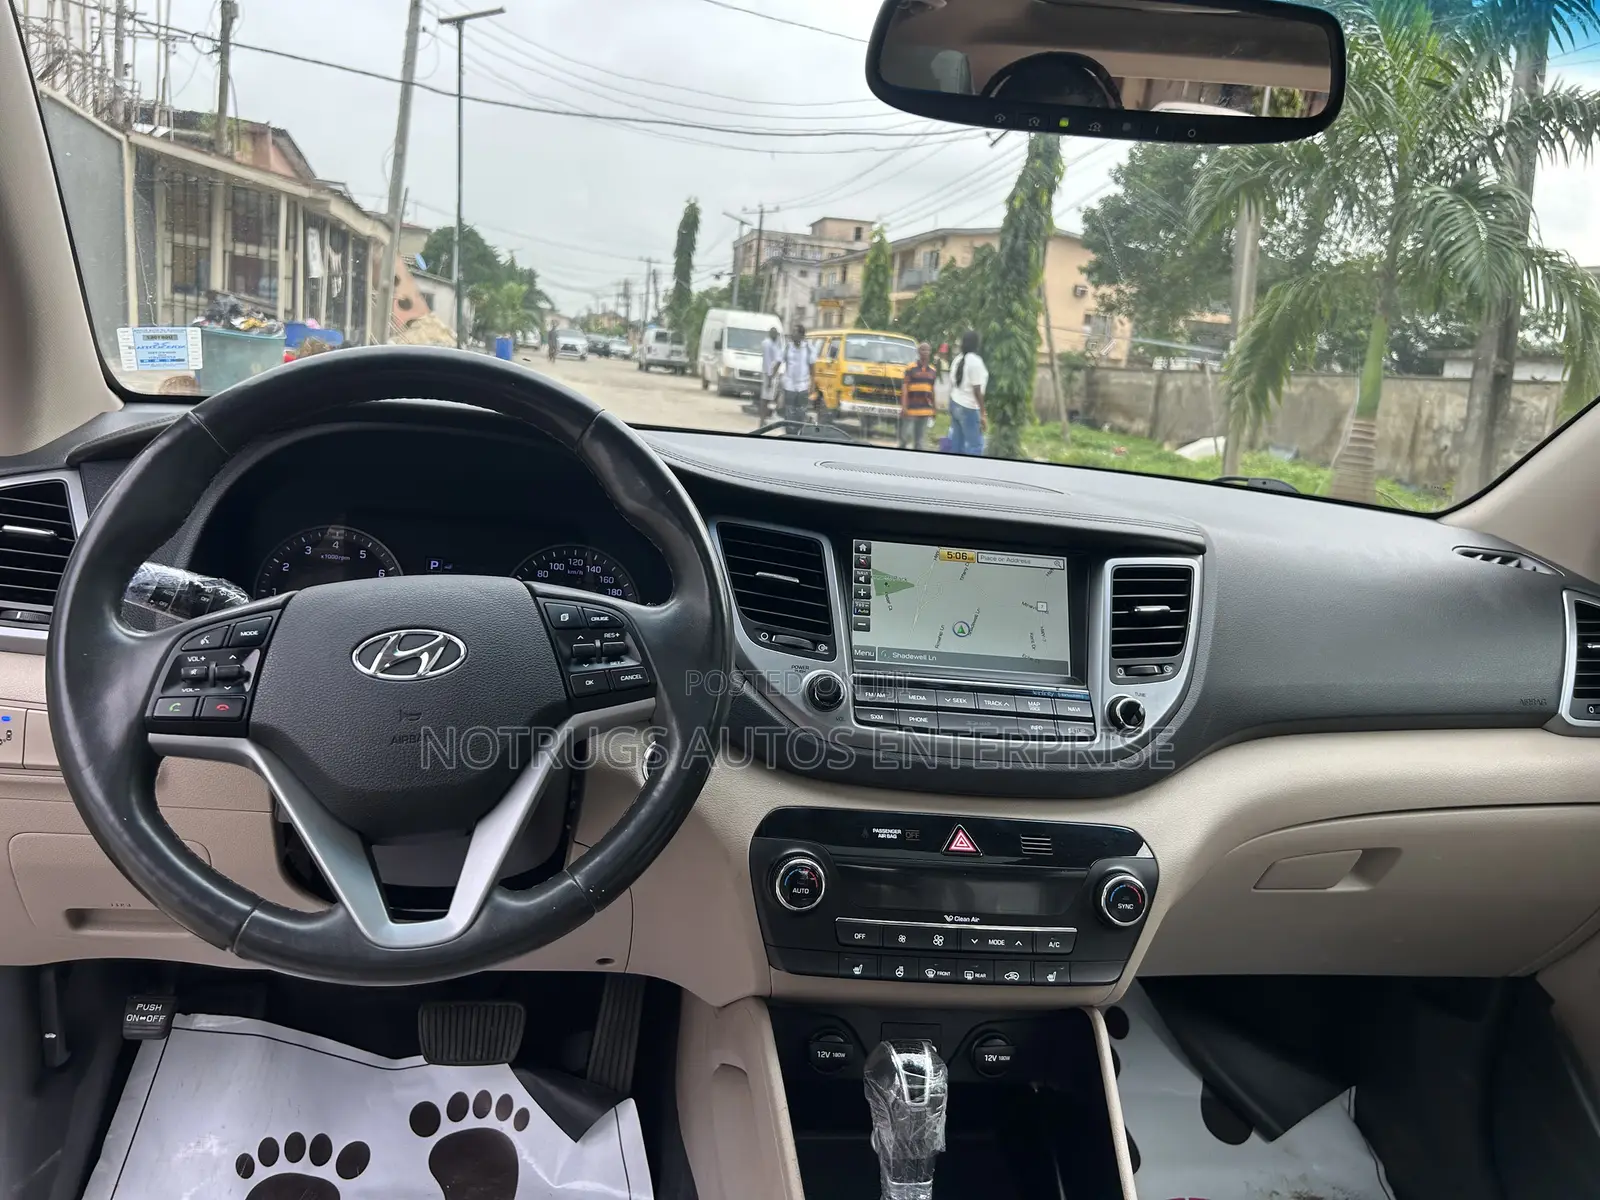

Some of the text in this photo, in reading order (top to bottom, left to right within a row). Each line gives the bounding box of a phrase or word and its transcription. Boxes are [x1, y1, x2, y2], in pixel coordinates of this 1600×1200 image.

[332, 540, 339, 549] 4
[304, 545, 312, 555] 3
[359, 550, 367, 559] 5
[947, 551, 968, 560] 5:06
[282, 562, 290, 572] 2
[430, 560, 439, 570] P
[549, 562, 565, 571] 100
[568, 558, 584, 567] 120
[378, 569, 386, 578] 6
[537, 570, 549, 578] 80
[586, 565, 601, 574] 140
[600, 576, 615, 584] 160
[271, 588, 277, 596] 1
[607, 588, 622, 597] 180
[854, 649, 875, 657] Menu
[892, 651, 927, 660] Shadewell
[905, 831, 920, 839] OFF
[988, 938, 1005, 946] MODE
[136, 1003, 162, 1011] PUSH
[816, 1050, 831, 1059] 12V
[984, 1054, 998, 1062] 12V
